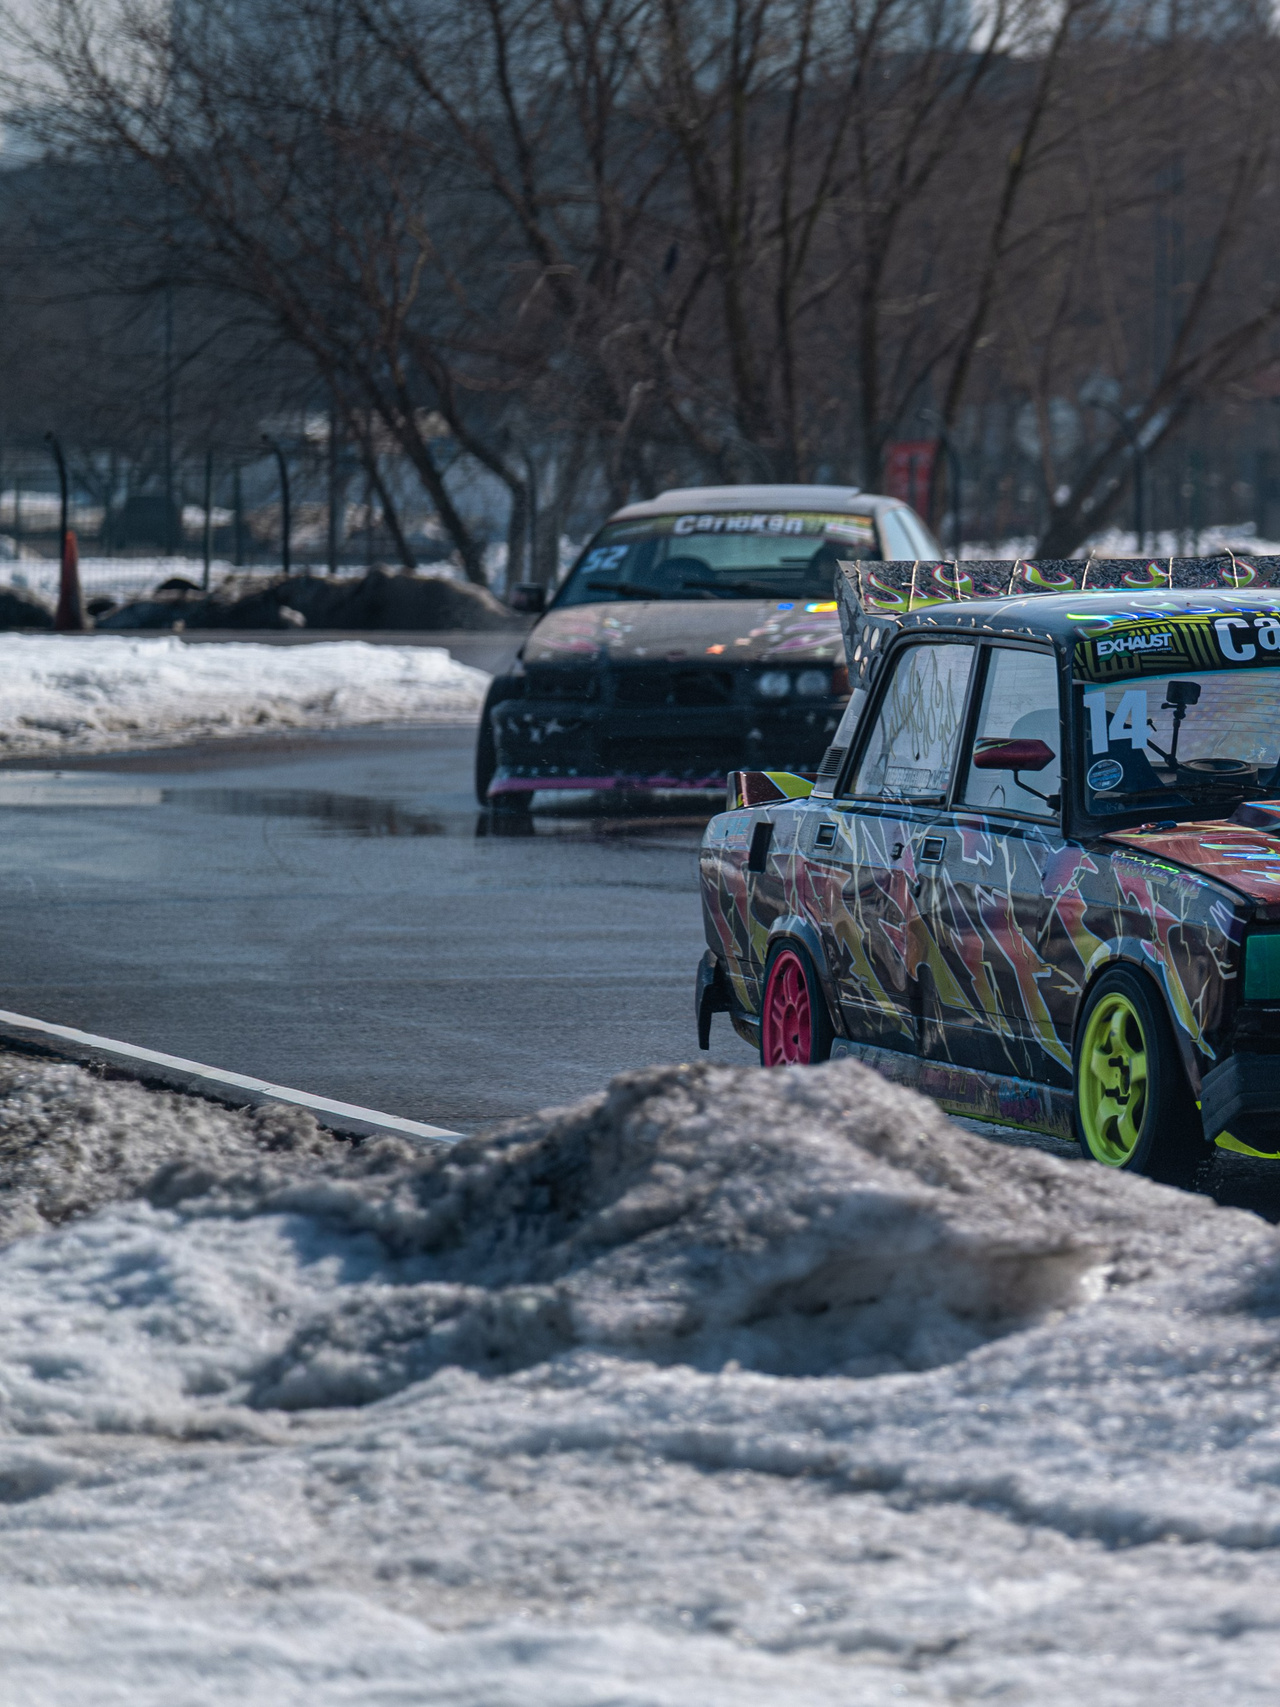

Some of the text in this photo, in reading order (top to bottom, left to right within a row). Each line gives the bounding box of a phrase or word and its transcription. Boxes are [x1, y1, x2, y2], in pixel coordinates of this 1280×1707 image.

[581, 545, 629, 574] 52
[1097, 633, 1172, 656] EXHAUST
[1083, 690, 1152, 755] 14
